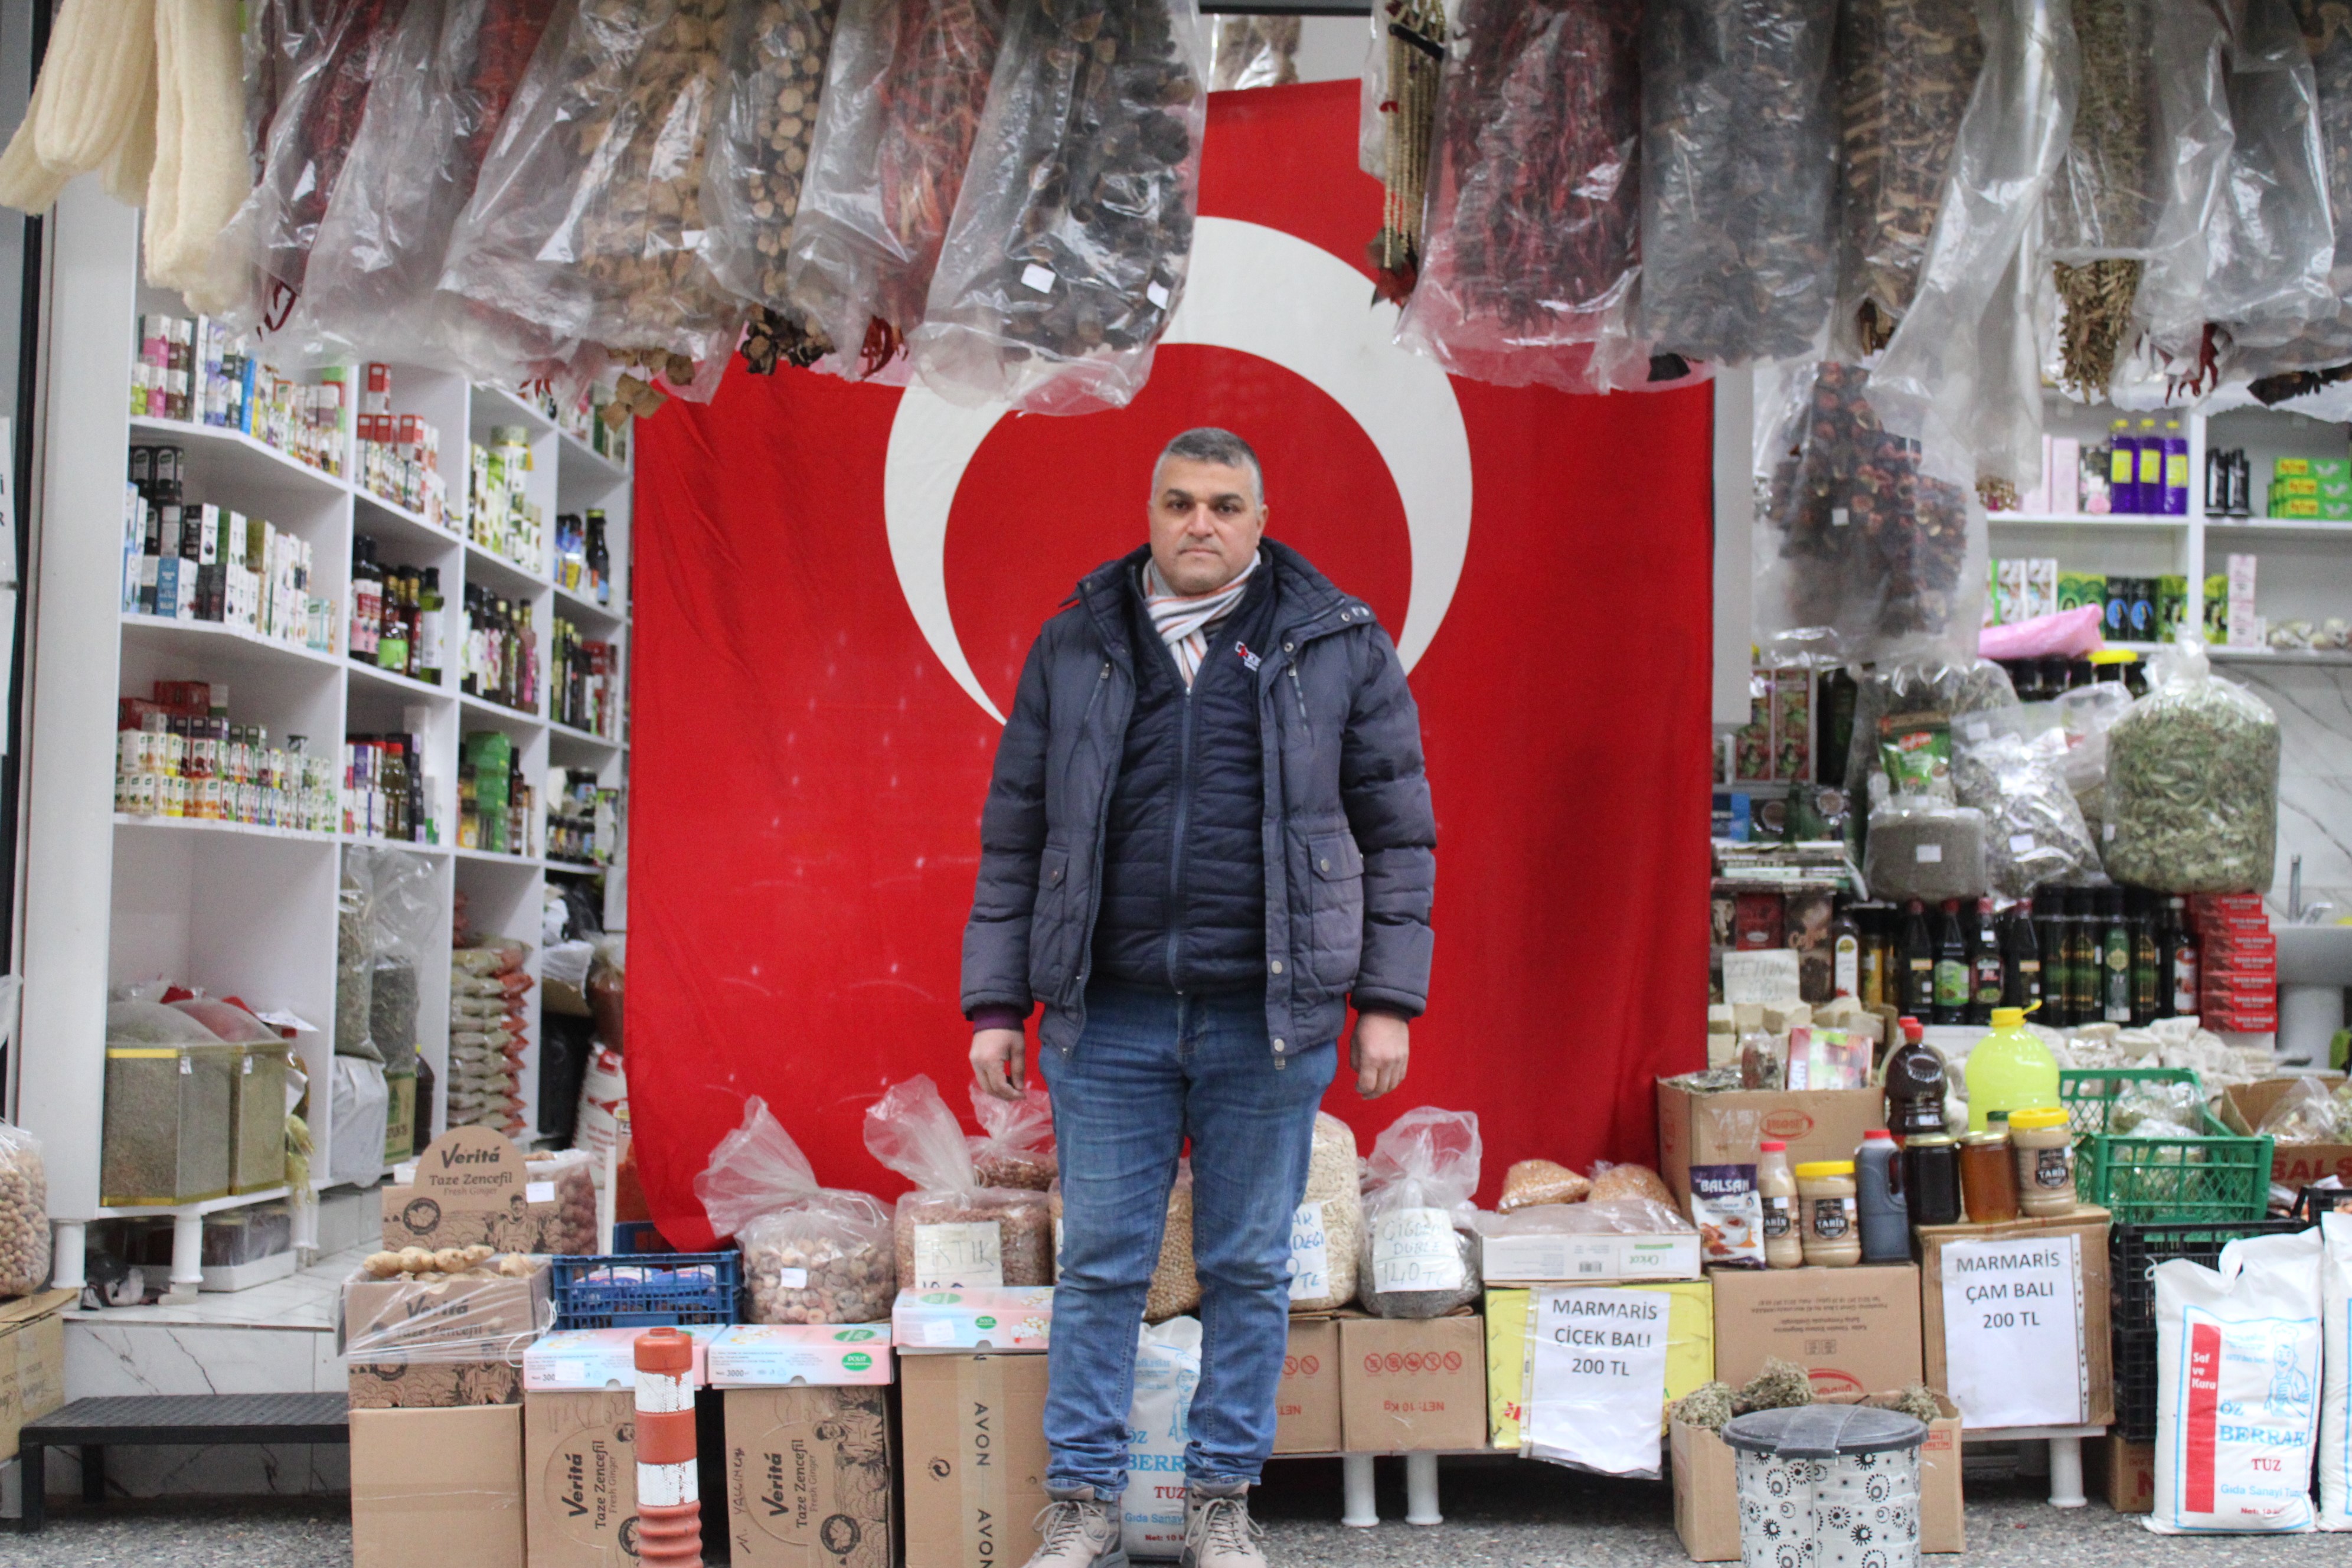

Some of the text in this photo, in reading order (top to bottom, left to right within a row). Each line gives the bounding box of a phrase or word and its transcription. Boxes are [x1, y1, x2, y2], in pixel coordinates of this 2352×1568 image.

[442, 1143, 501, 1168] Veritá
[429, 1171, 513, 1187] Taze Zencefil
[2271, 1157, 2352, 1181] BALS
[444, 1187, 498, 1197] Fresh Ginger
[1956, 1249, 2060, 1273] MARMARİS
[1384, 1262, 1420, 1285] 140
[1966, 1281, 2054, 1305] ÇAM BALI
[1553, 1299, 1658, 1320] MARMARİS
[1983, 1311, 2040, 1329] 200 TL
[1555, 1325, 1651, 1348] ÇİÇEK BALI
[1572, 1358, 1630, 1376] 200 TL
[2192, 1351, 2211, 1364] Saf
[2191, 1366, 2206, 1376] ve
[2191, 1377, 2217, 1390] Kuru
[1384, 1400, 1399, 1412] Kg
[1403, 1402, 1415, 1412] 10
[2220, 1399, 2244, 1416] ÖZ
[974, 1402, 991, 1466] AVON
[2219, 1425, 2305, 1446] BERRAK
[1127, 1454, 1186, 1472] BERR
[2251, 1458, 2282, 1472] TUZ
[561, 1453, 589, 1517] Veritá
[592, 1439, 609, 1530] Taze Zencefil
[609, 1456, 619, 1514] Fresh Ginger
[762, 1452, 789, 1517] Veritá
[792, 1439, 808, 1529] Taze Zencefil
[808, 1455, 819, 1513] Fresh Ginger
[1154, 1486, 1187, 1499] TUZ
[2220, 1484, 2246, 1495] Gıda
[2249, 1485, 2283, 1498] Sanayi
[1125, 1513, 1185, 1525] Gıda Sanay
[977, 1508, 994, 1568] AVON
